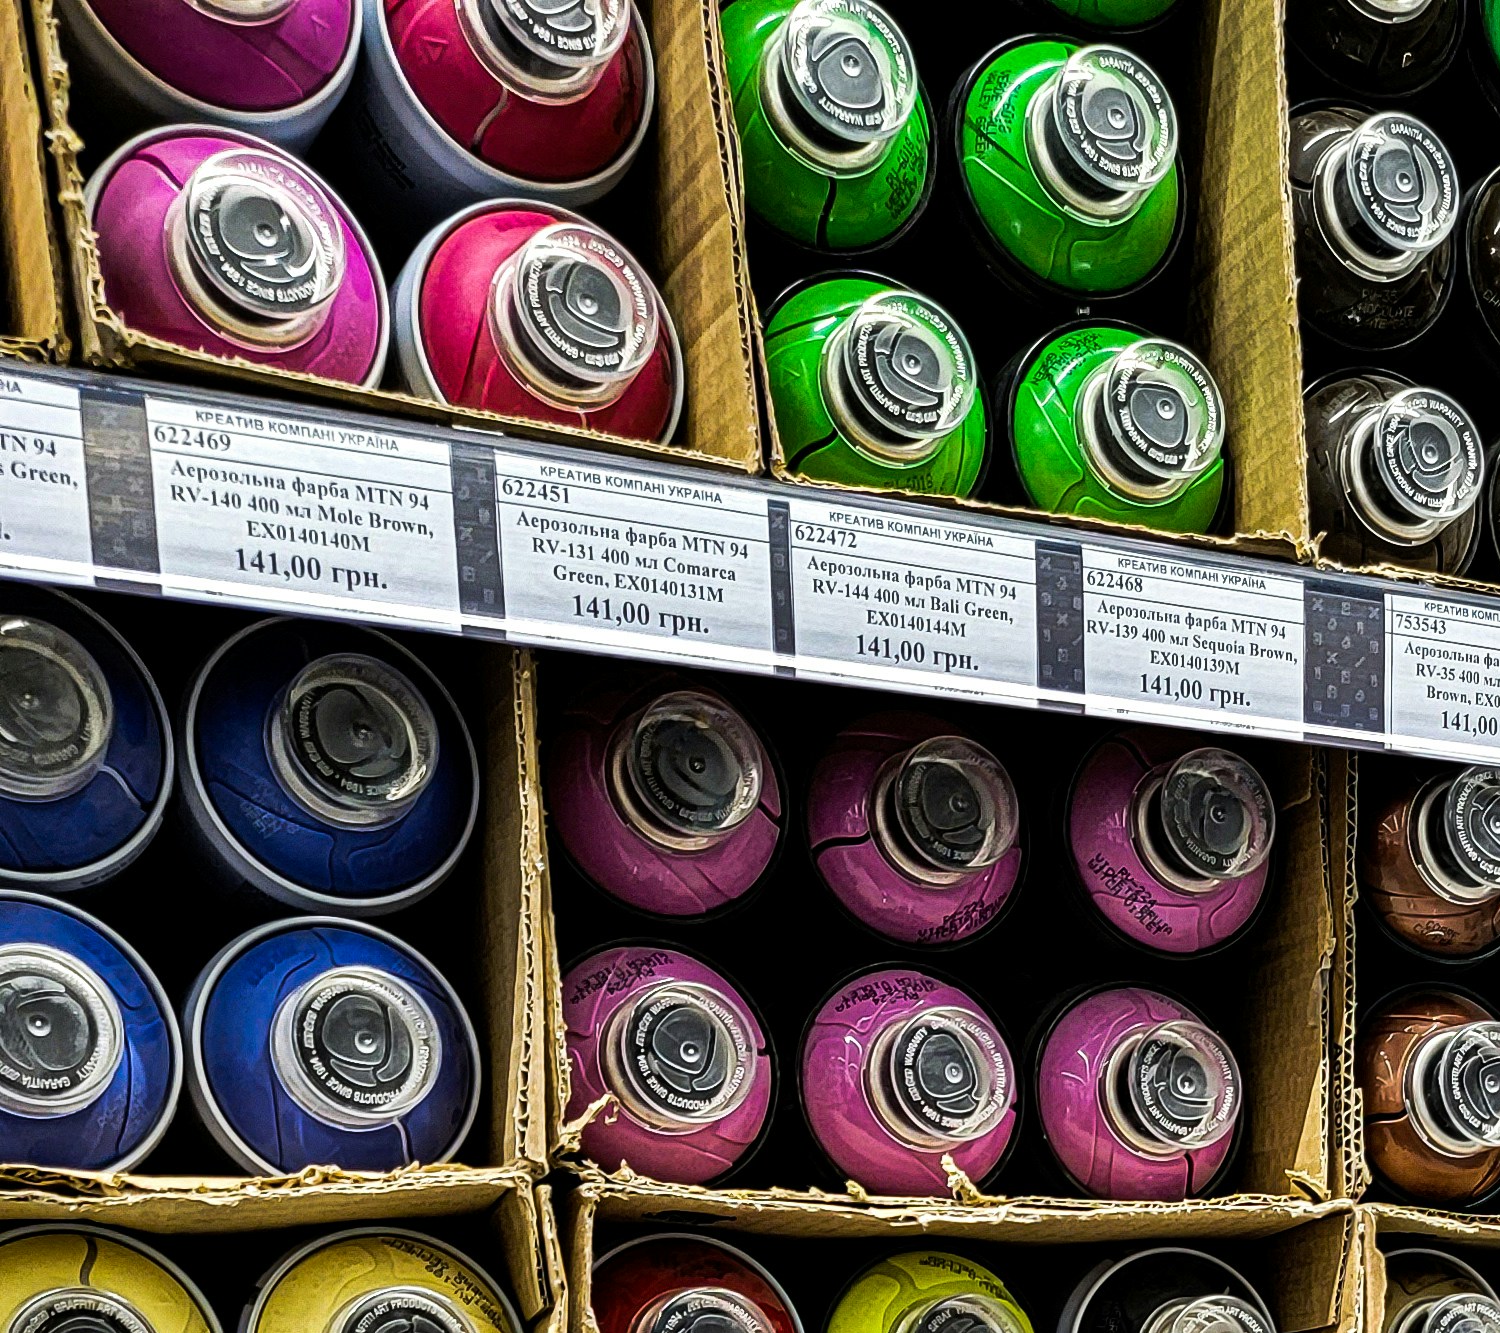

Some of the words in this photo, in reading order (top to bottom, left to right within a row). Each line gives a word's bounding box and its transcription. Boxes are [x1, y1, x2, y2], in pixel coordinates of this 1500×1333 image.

[153, 425, 231, 452] 622469
[195, 410, 265, 431] КРЕАТИВ
[268, 421, 334, 439] КОМПАНІ
[171, 460, 286, 491] Аерозольна
[291, 476, 350, 501] фарба
[408, 492, 429, 511] 94
[502, 478, 569, 504] 622451
[540, 465, 602, 485] КРЕАТИВ
[605, 475, 665, 495] КОМПАНІ
[170, 484, 242, 509] RV-140
[247, 494, 280, 515] 400
[285, 504, 311, 519] мл
[317, 504, 363, 526] Mole
[368, 511, 434, 539] Brown,
[246, 520, 371, 553] EX0140140M
[516, 510, 620, 541] Аерозольна
[625, 526, 677, 550] фарба
[730, 542, 748, 560] 94
[795, 524, 858, 549] 622472
[235, 548, 322, 582] 141,00
[331, 566, 388, 592] грн.
[532, 536, 594, 561] RV-131
[600, 547, 630, 566] 400
[635, 556, 658, 570] мл
[663, 556, 736, 582] Comarca
[1117, 557, 1167, 575] КРЕАТИВ
[1170, 565, 1219, 583] КОМПАНІ
[553, 564, 610, 589] Green,
[613, 572, 724, 603] EX0140131M
[1086, 570, 1143, 593] 622468
[572, 594, 650, 627] 141,00
[658, 612, 709, 637] грн.
[1097, 599, 1181, 625] Аерозольна
[1184, 611, 1227, 632] фарба
[1270, 624, 1286, 640] 94
[1395, 613, 1447, 635] 753543
[856, 634, 926, 665] 141,00
[932, 650, 979, 673] грн.
[1086, 619, 1139, 640] RV-139
[1141, 627, 1166, 644] 400
[1169, 634, 1189, 647] мл
[1192, 634, 1245, 655] Sequoia
[1249, 642, 1298, 666] Brown,
[1150, 649, 1240, 676] EX0140139M
[1140, 673, 1203, 702] 141,00
[1209, 687, 1251, 710] грн.
[1441, 710, 1498, 738] 141,00
